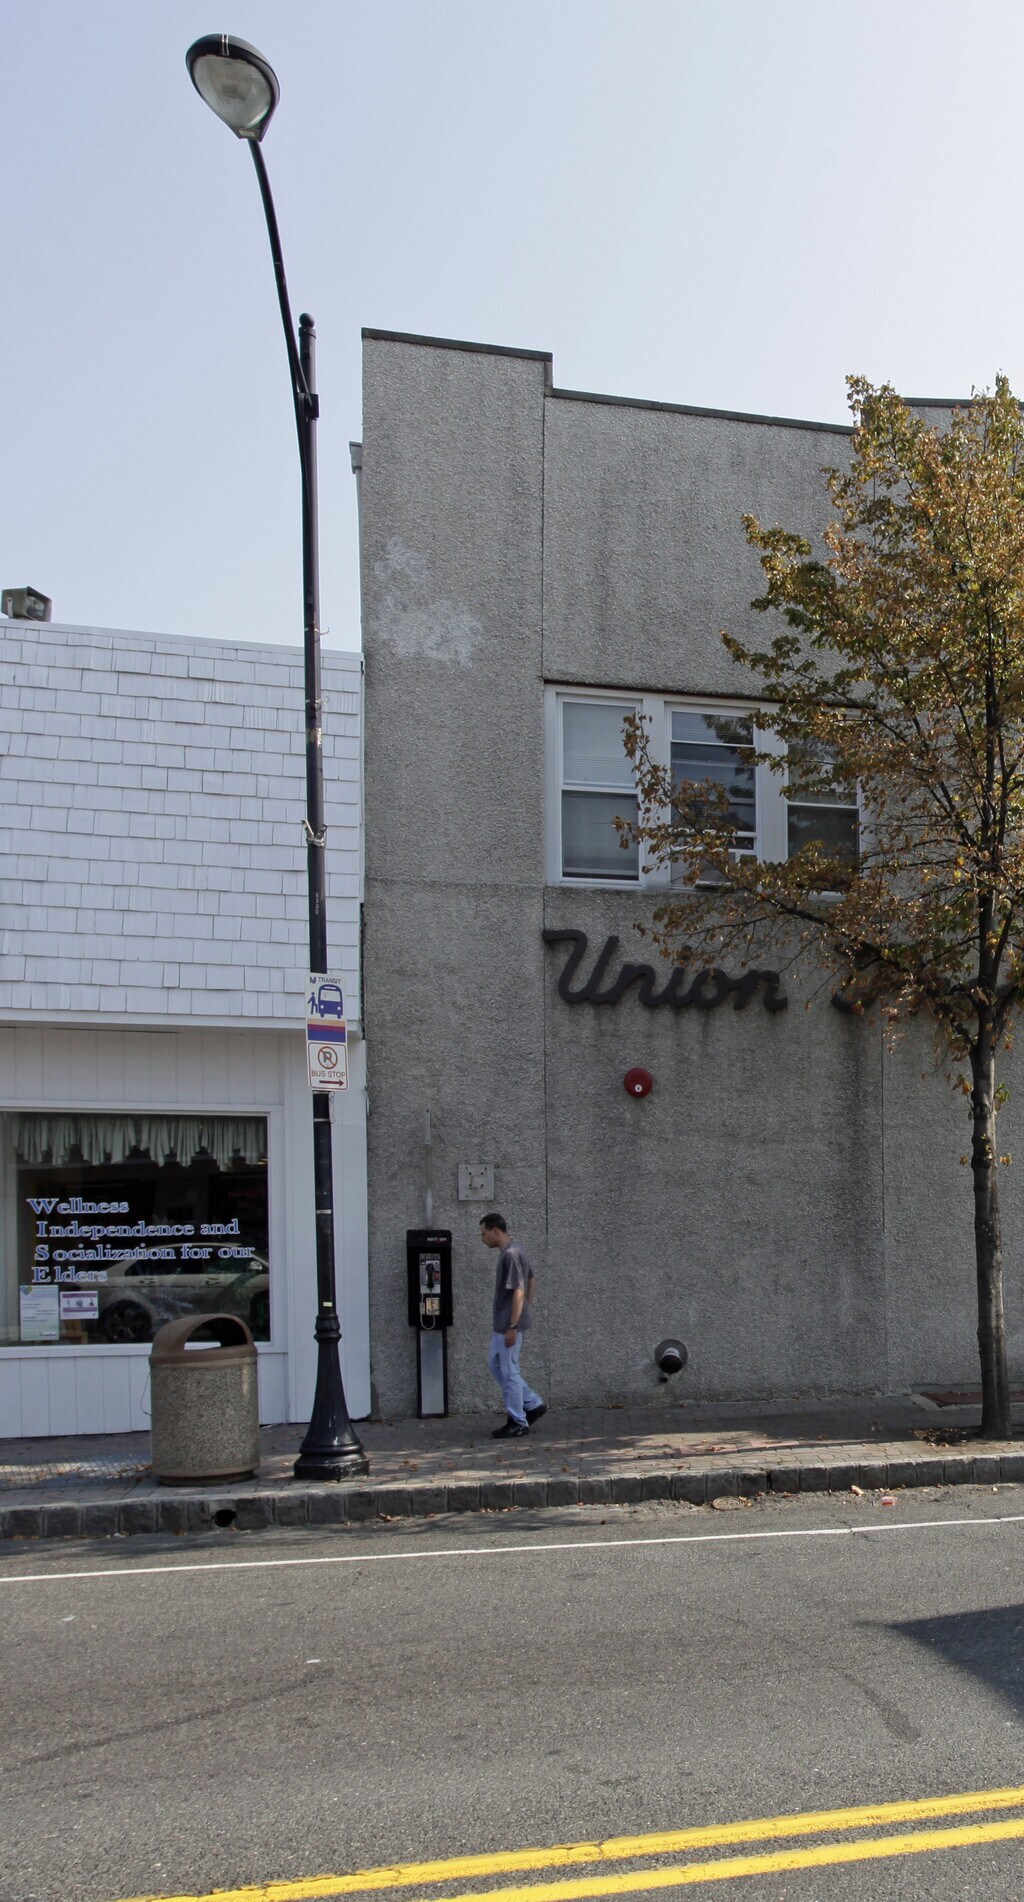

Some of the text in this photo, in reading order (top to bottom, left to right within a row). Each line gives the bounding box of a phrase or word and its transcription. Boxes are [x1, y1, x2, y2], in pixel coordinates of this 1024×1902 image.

[542, 929, 788, 1010] Union
[318, 976, 341, 985] TRANSIT
[311, 1069, 345, 1079] BUS STOP
[27, 1197, 129, 1214] Wellness
[200, 1219, 240, 1235] and
[181, 1243, 213, 1259] for
[217, 1246, 255, 1259] our
